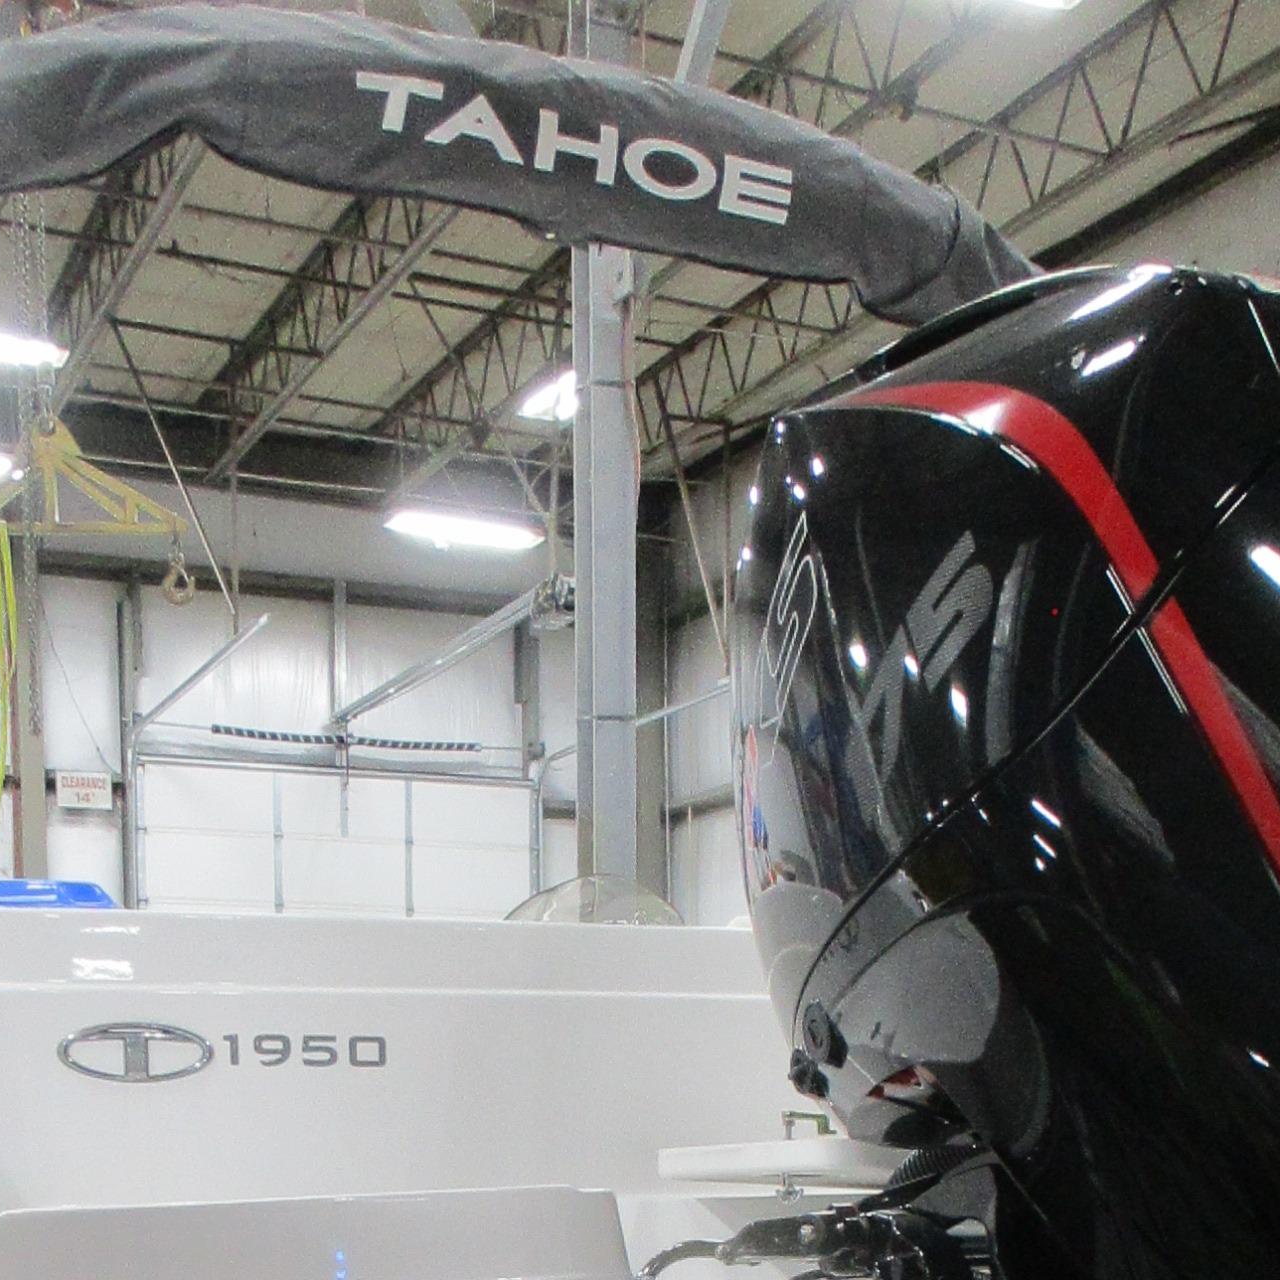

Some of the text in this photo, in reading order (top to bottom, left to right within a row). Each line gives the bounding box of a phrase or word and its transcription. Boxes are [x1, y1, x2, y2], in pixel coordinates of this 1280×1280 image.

[355, 71, 794, 226] TAHOE
[60, 775, 107, 790] CLEARANCE
[222, 1032, 387, 1068] 1950
